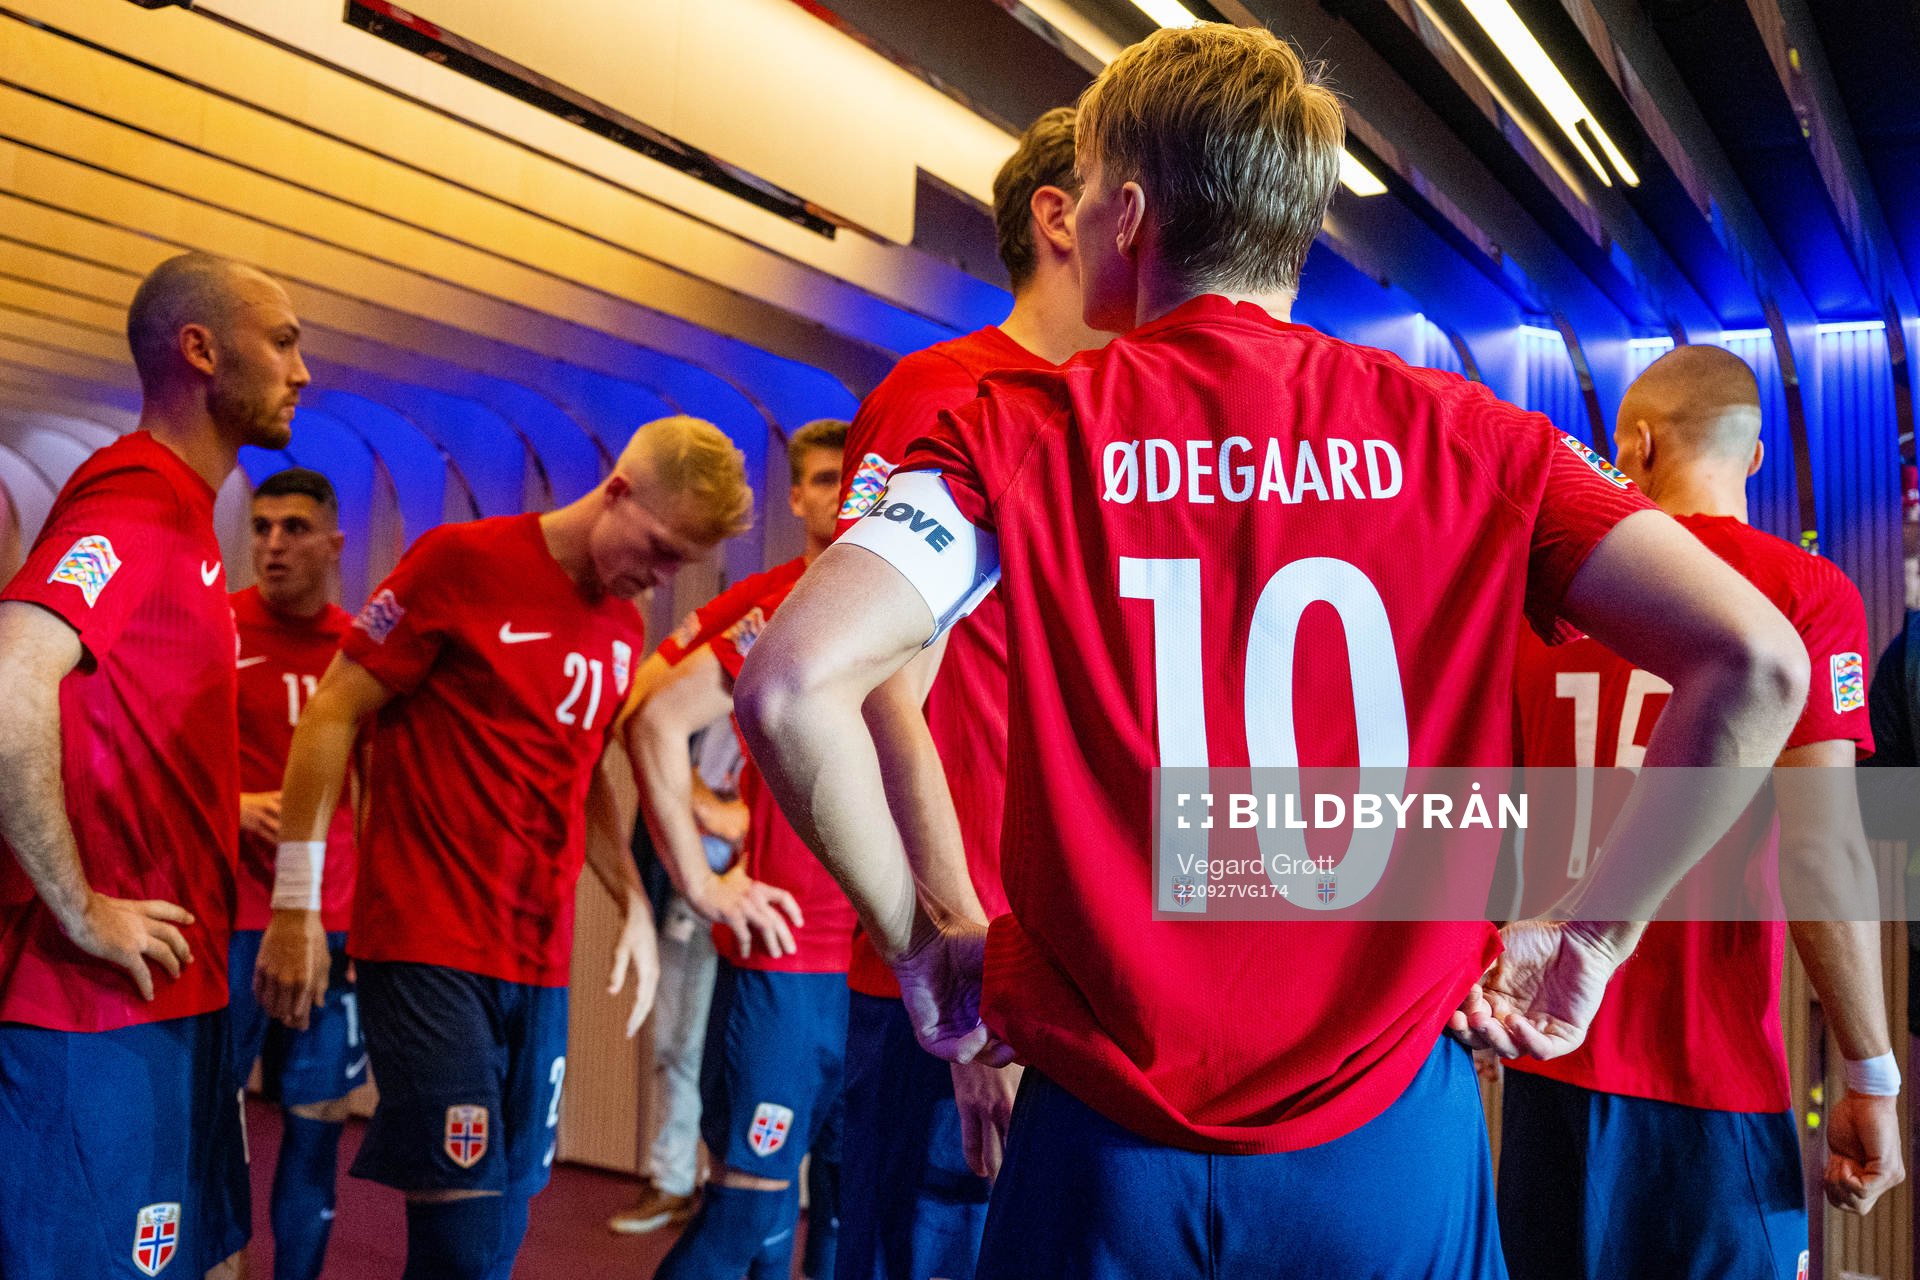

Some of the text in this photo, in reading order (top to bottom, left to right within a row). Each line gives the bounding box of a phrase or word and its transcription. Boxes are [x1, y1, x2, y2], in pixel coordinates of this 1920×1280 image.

[1102, 436, 1403, 504] ØDEGAARD
[867, 499, 955, 553] LOVE
[555, 652, 603, 730] 21
[1119, 556, 1409, 913] 10
